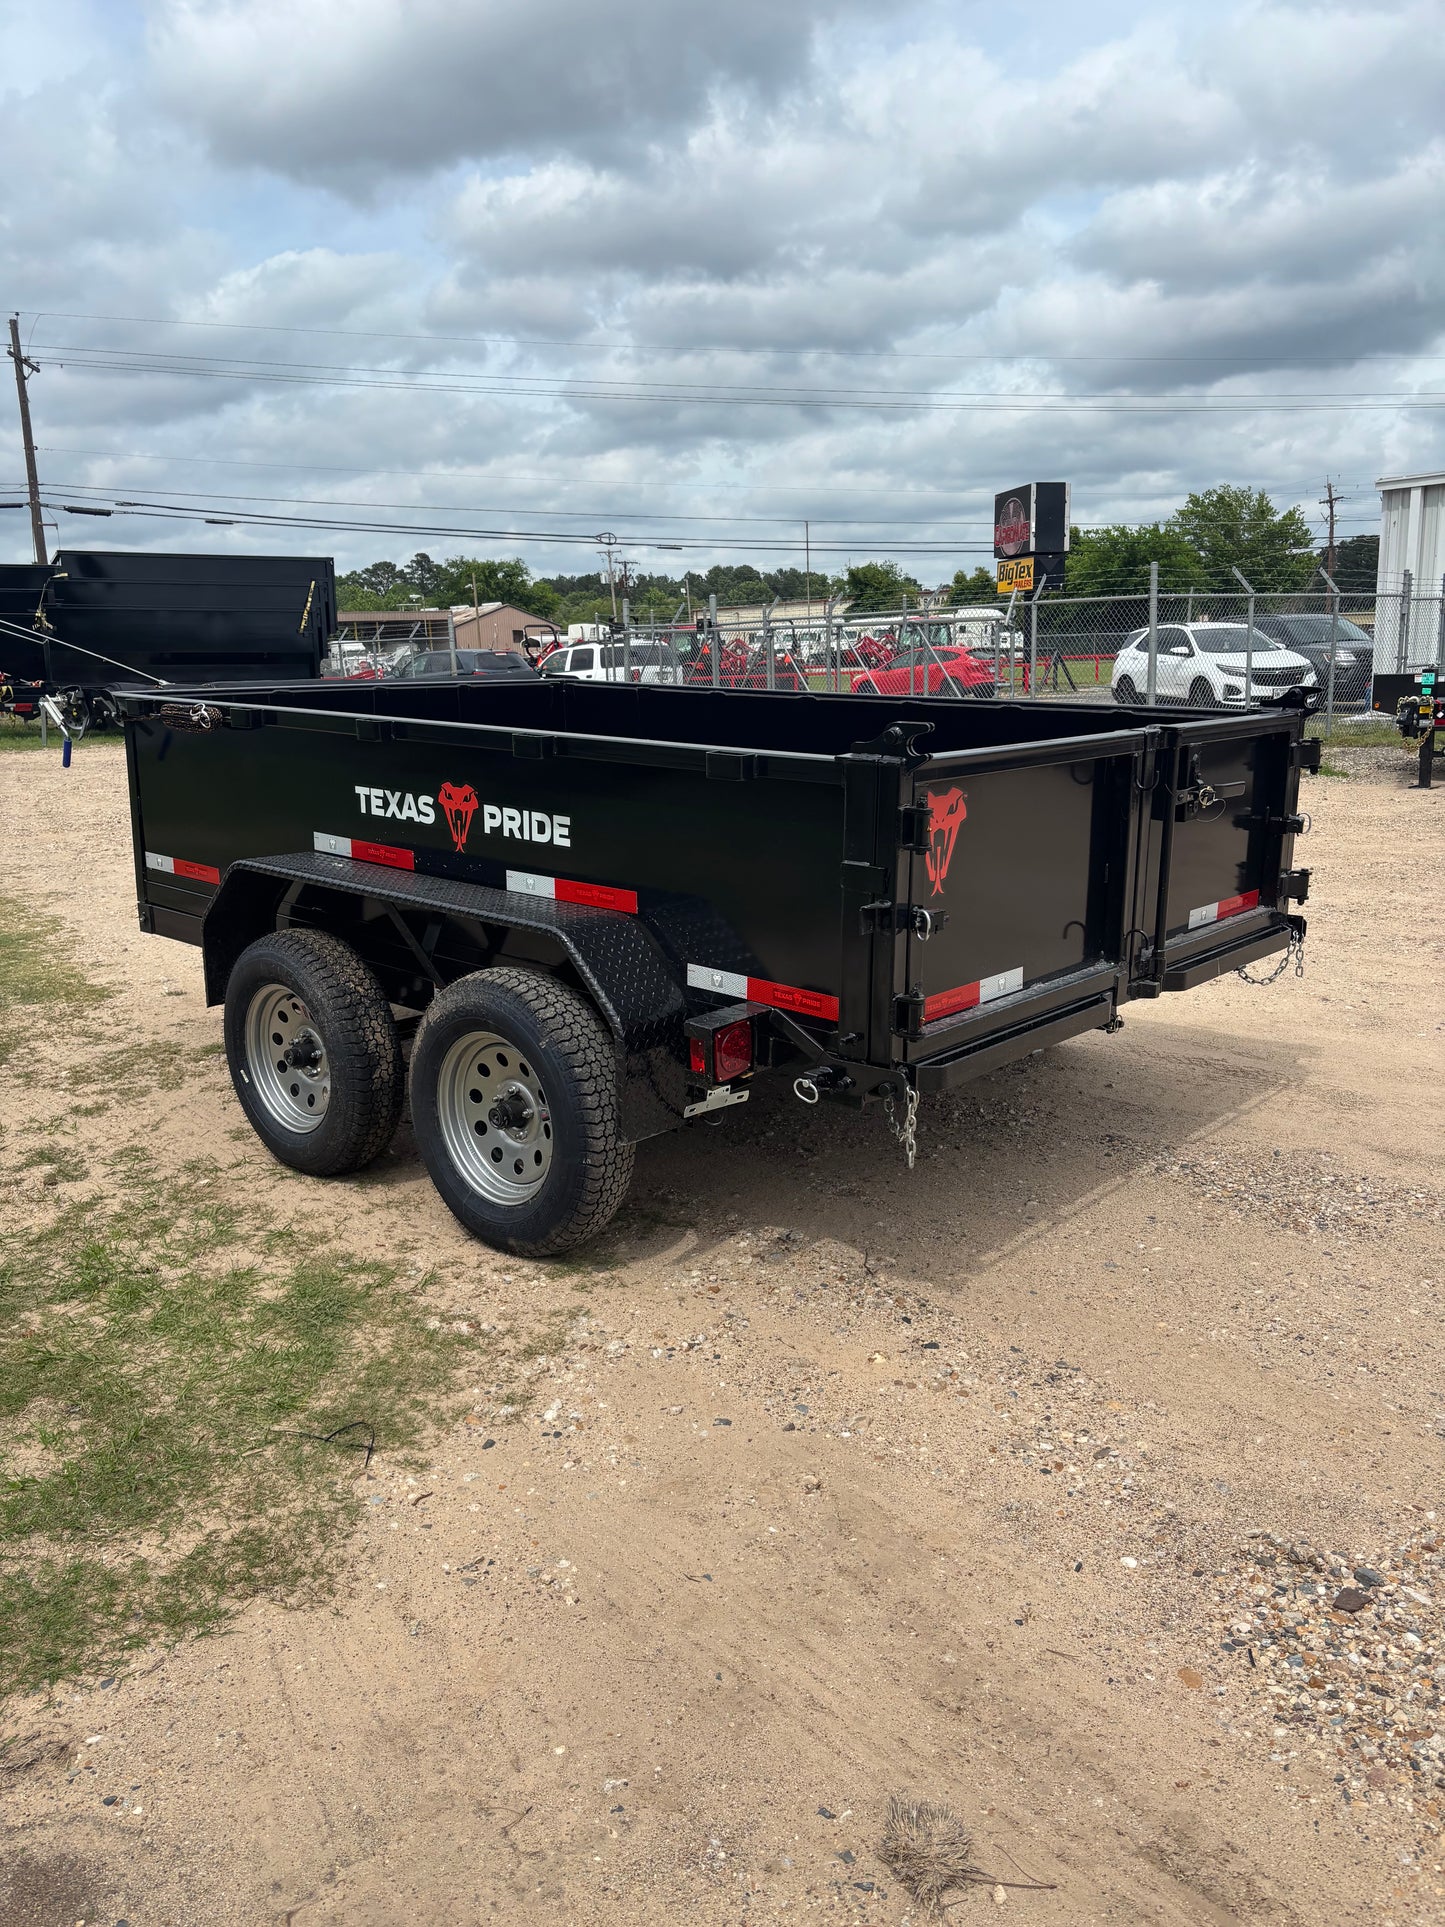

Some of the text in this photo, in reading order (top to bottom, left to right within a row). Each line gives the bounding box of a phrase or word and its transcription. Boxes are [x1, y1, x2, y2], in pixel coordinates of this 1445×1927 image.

[1013, 579, 1032, 590] TRAILERS
[354, 785, 572, 848] TEXAS PRIDE
[774, 991, 821, 1008] TEXAS PRIDE
